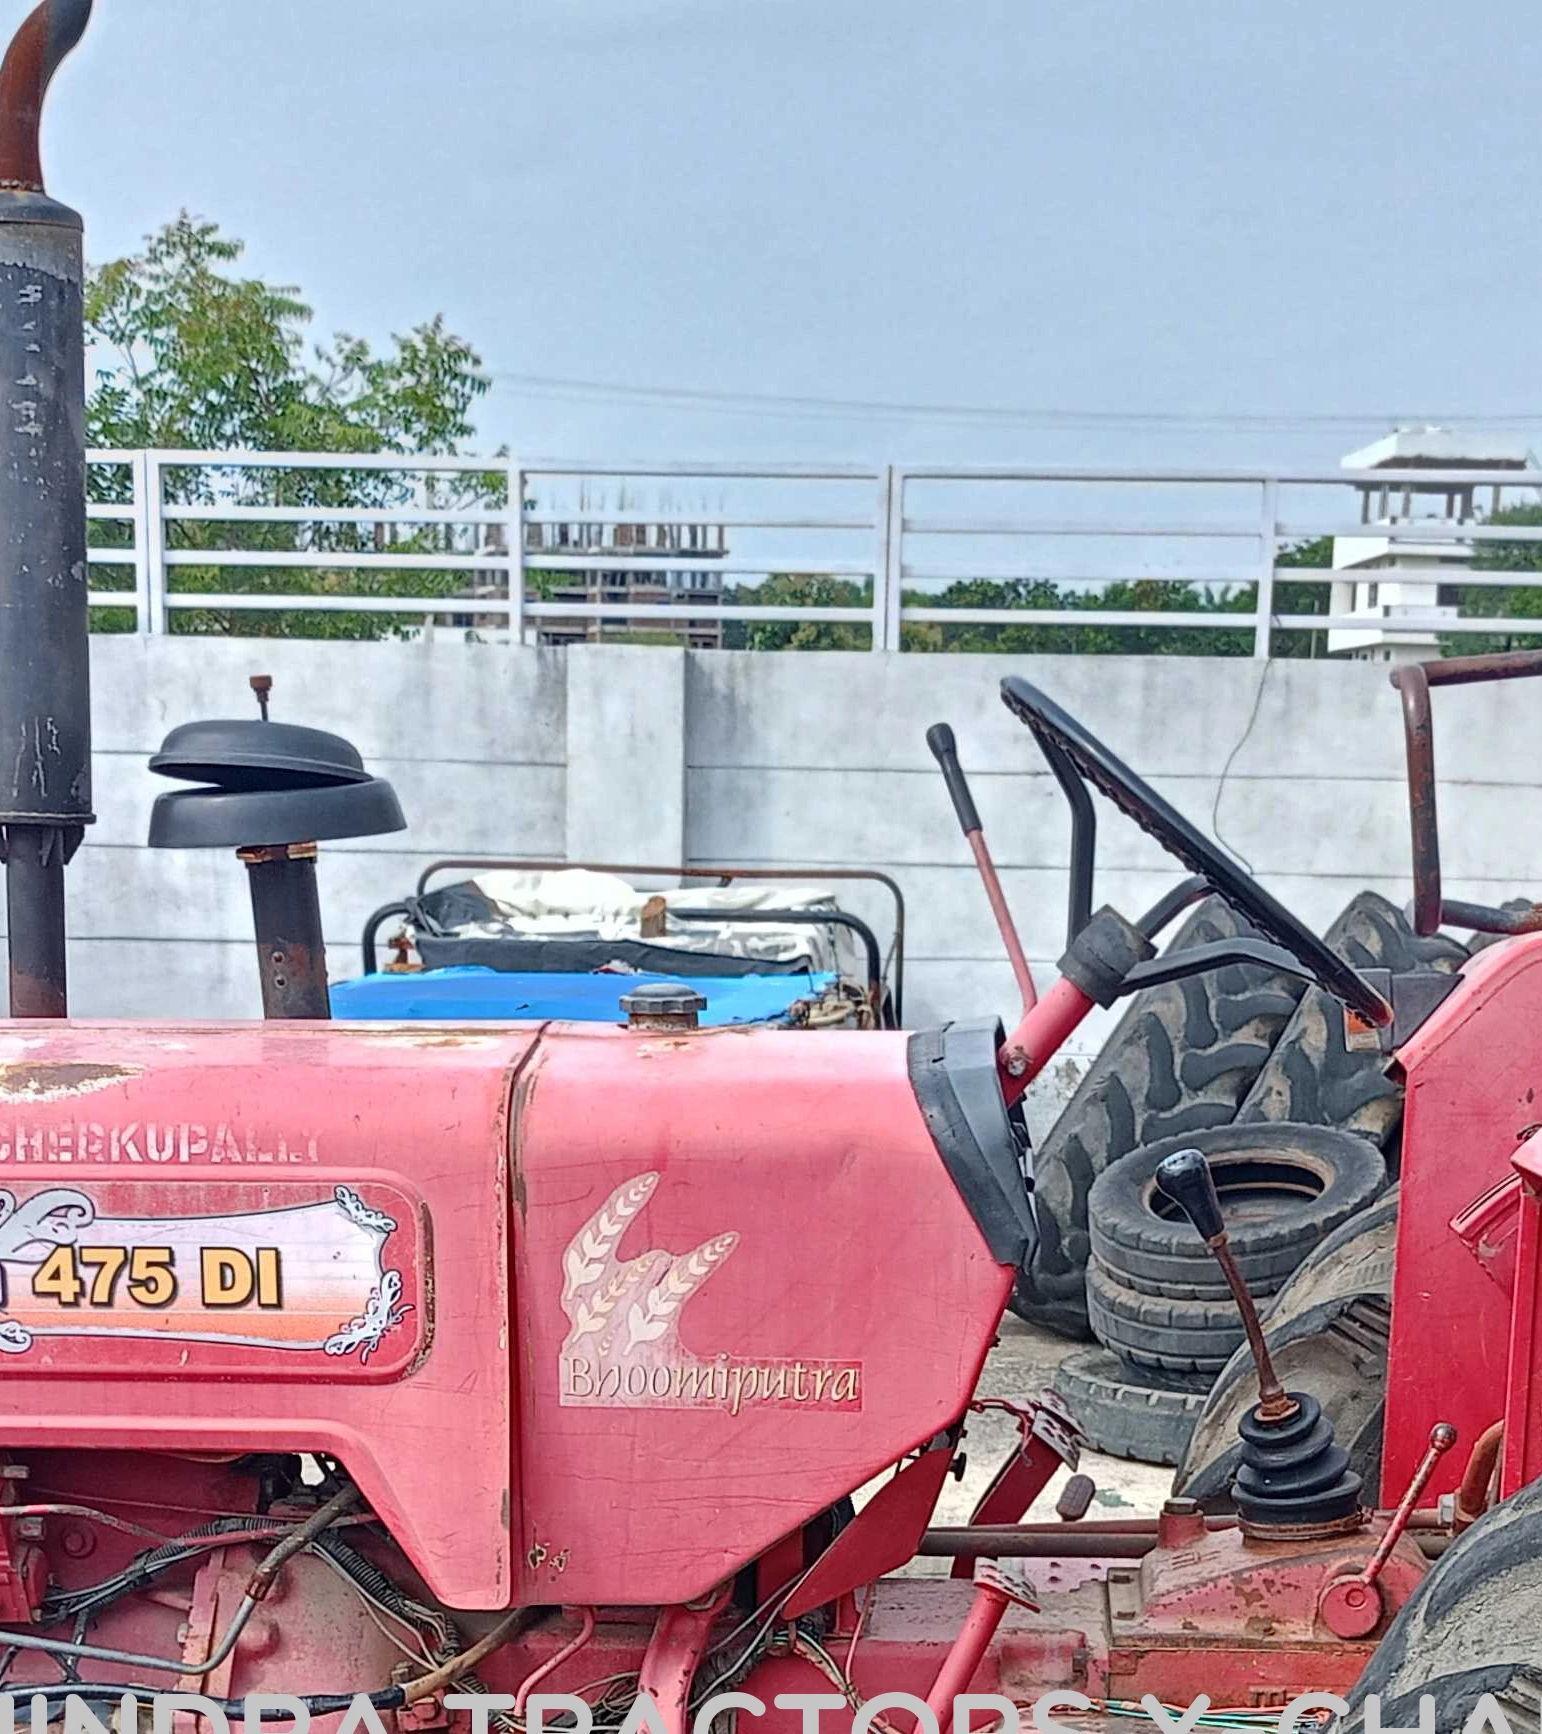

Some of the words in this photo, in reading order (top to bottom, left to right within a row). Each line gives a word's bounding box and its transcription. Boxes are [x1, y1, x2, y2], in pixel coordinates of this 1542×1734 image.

[32, 1244, 177, 1308] 475
[200, 1246, 282, 1309] DI
[564, 1352, 860, 1416] Bhoomiputra
